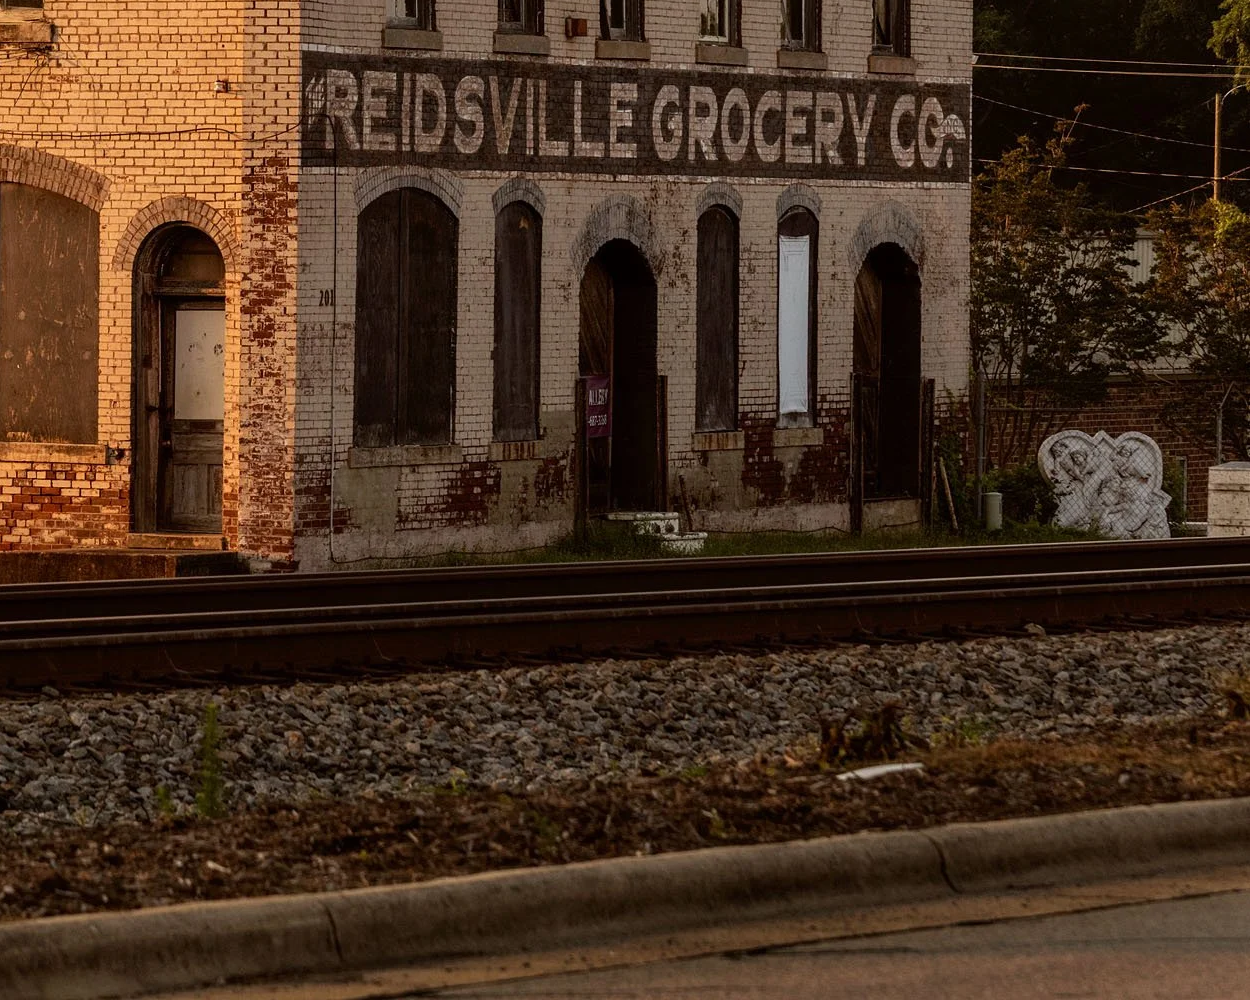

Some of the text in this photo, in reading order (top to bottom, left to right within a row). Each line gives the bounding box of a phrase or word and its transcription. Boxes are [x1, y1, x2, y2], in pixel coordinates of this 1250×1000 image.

[326, 69, 638, 158] REIDSVILLE
[652, 84, 877, 166] GROCERY
[318, 289, 334, 307] 201
